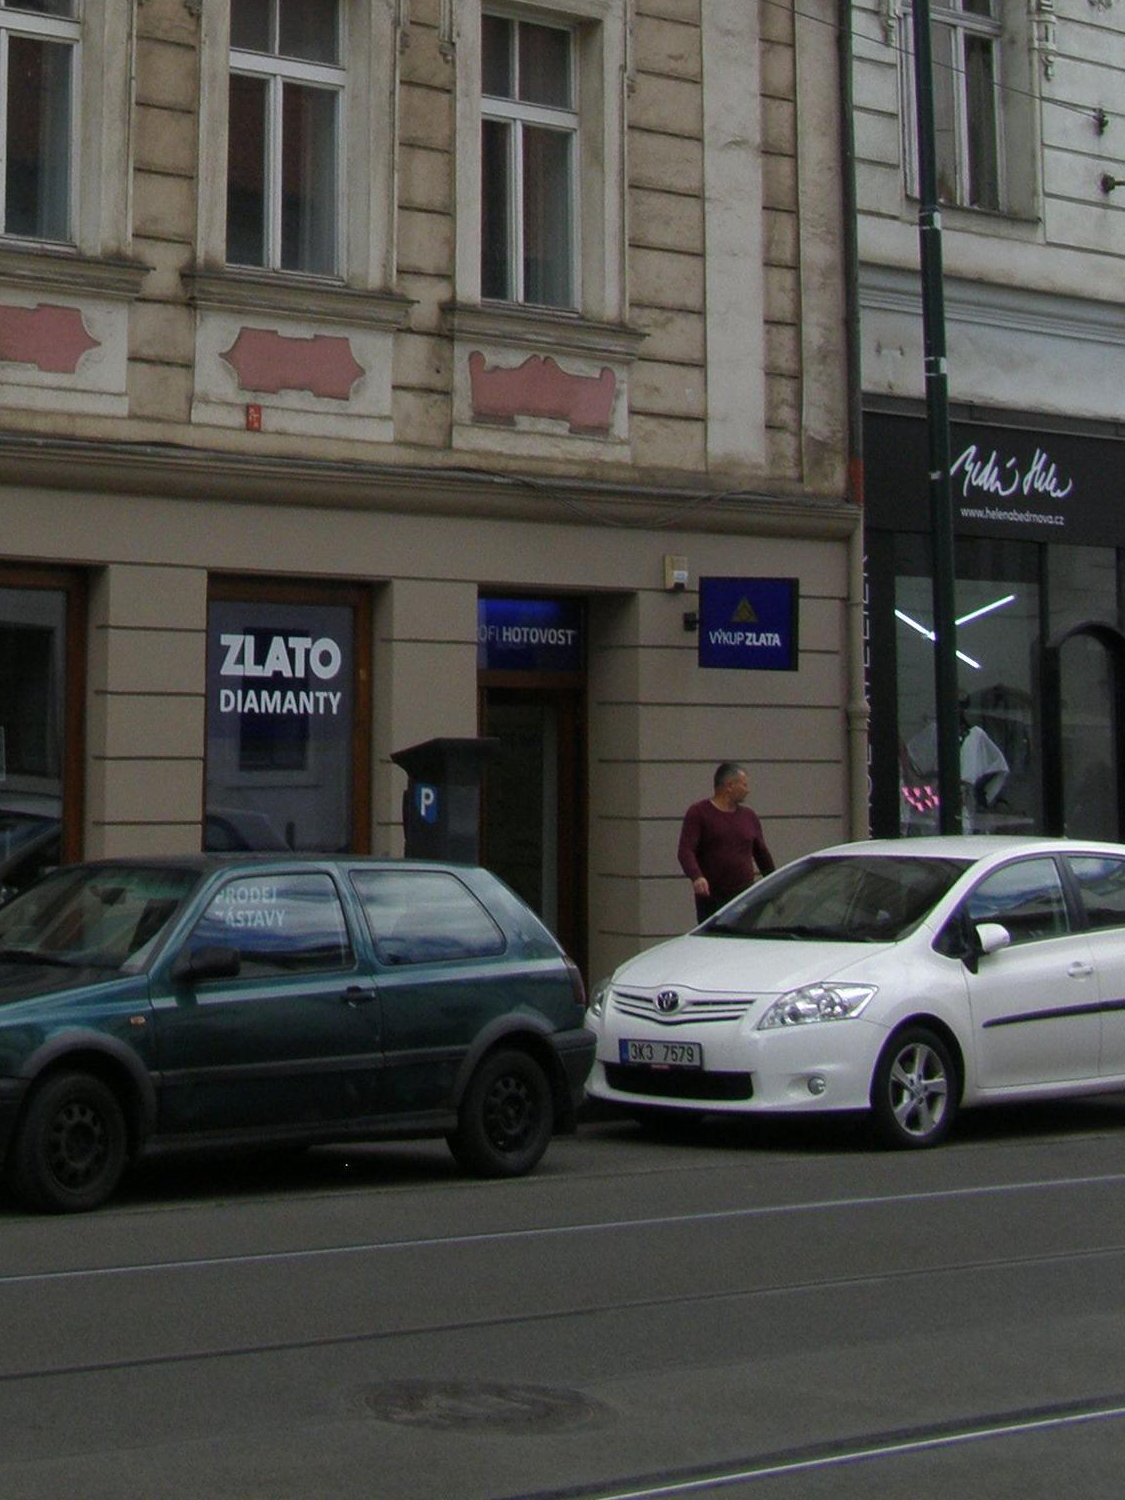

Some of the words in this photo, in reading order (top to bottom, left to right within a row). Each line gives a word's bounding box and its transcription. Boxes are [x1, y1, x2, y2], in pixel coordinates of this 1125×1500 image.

[502, 626, 575, 646] HOTOVOST
[708, 628, 744, 646] VÝKUP
[744, 632, 782, 648] ZLATA
[219, 633, 342, 680] ZLATO
[219, 689, 342, 716] DIAMANTY
[420, 786, 435, 817] P
[630, 1042, 654, 1061] 3K3
[662, 1044, 695, 1063] 7579
